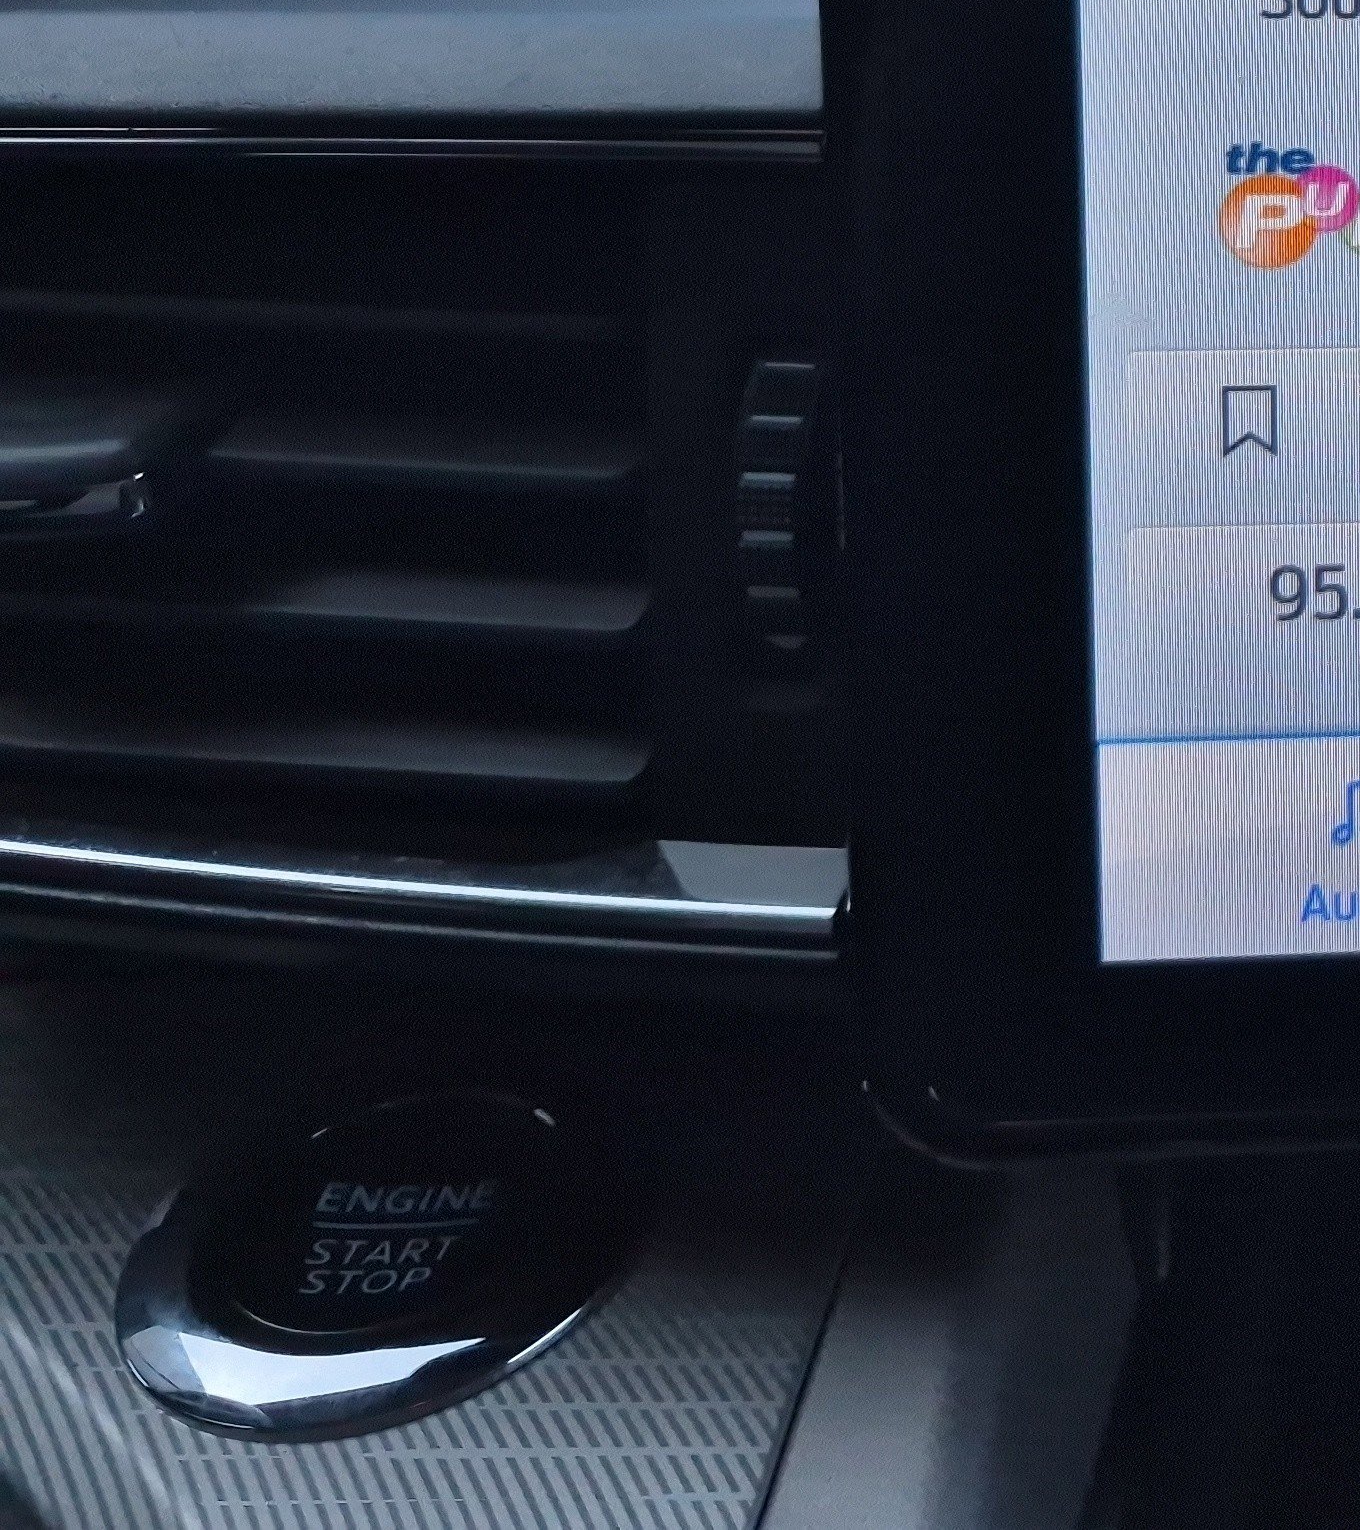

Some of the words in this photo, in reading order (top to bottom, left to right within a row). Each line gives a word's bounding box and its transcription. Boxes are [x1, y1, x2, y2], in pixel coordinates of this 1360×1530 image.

[1225, 143, 1315, 175] the
[315, 1182, 496, 1215] ENGINE
[305, 1236, 460, 1266] START
[300, 1267, 431, 1296] STOP
